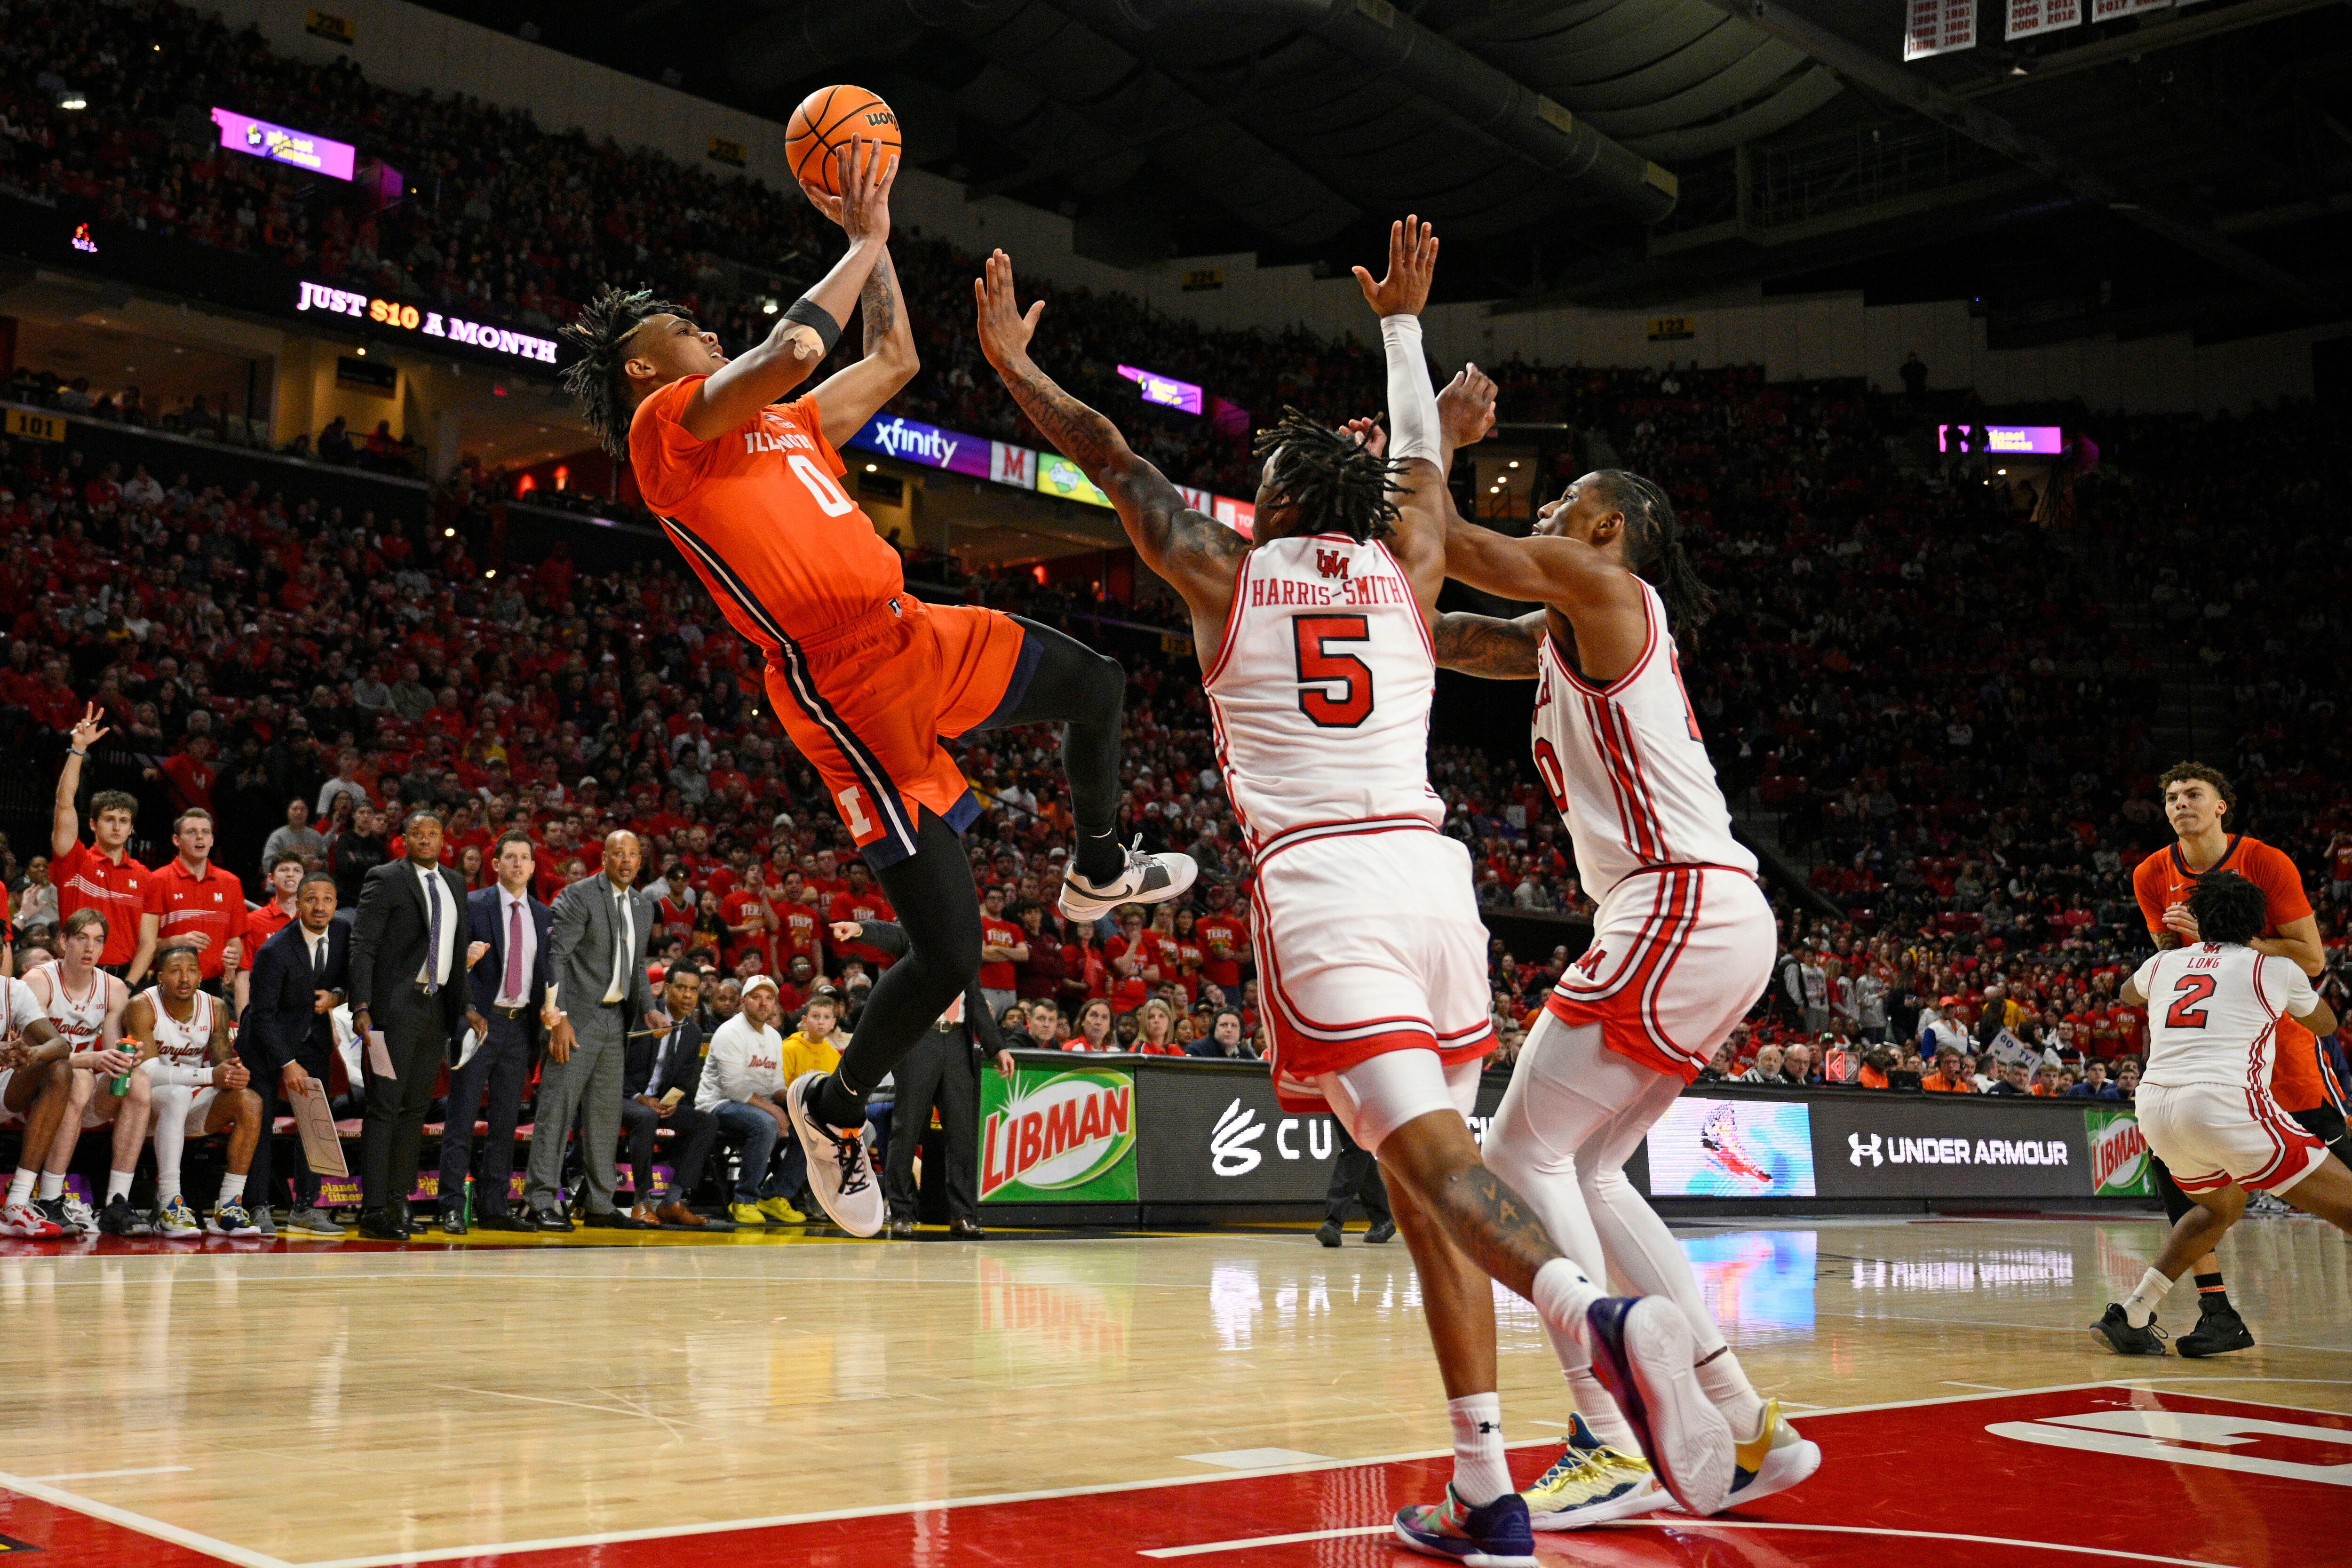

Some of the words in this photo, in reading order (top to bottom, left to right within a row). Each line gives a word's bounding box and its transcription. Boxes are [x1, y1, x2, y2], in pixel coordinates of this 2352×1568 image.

[297, 281, 366, 317] JUST
[421, 312, 445, 337] A
[448, 317, 557, 364] MONTH
[20, 415, 52, 437] 101
[875, 418, 957, 469] xfinity
[1004, 446, 1024, 480] M
[787, 455, 852, 517] 0
[1237, 514, 1254, 527] TO
[1252, 575, 1404, 607] HARRIS-SMITH
[1292, 614, 1374, 728] 5
[837, 785, 872, 838] I
[214, 892, 223, 902] M
[2186, 957, 2222, 968] LONG
[2165, 974, 2217, 1029] 2
[2001, 1035, 2013, 1048] GO
[980, 1085, 1130, 1198] LIBMAN
[1887, 1137, 1971, 1164] UNDER
[1974, 1138, 2068, 1166] ARMOUR
[321, 1182, 358, 1195] planet
